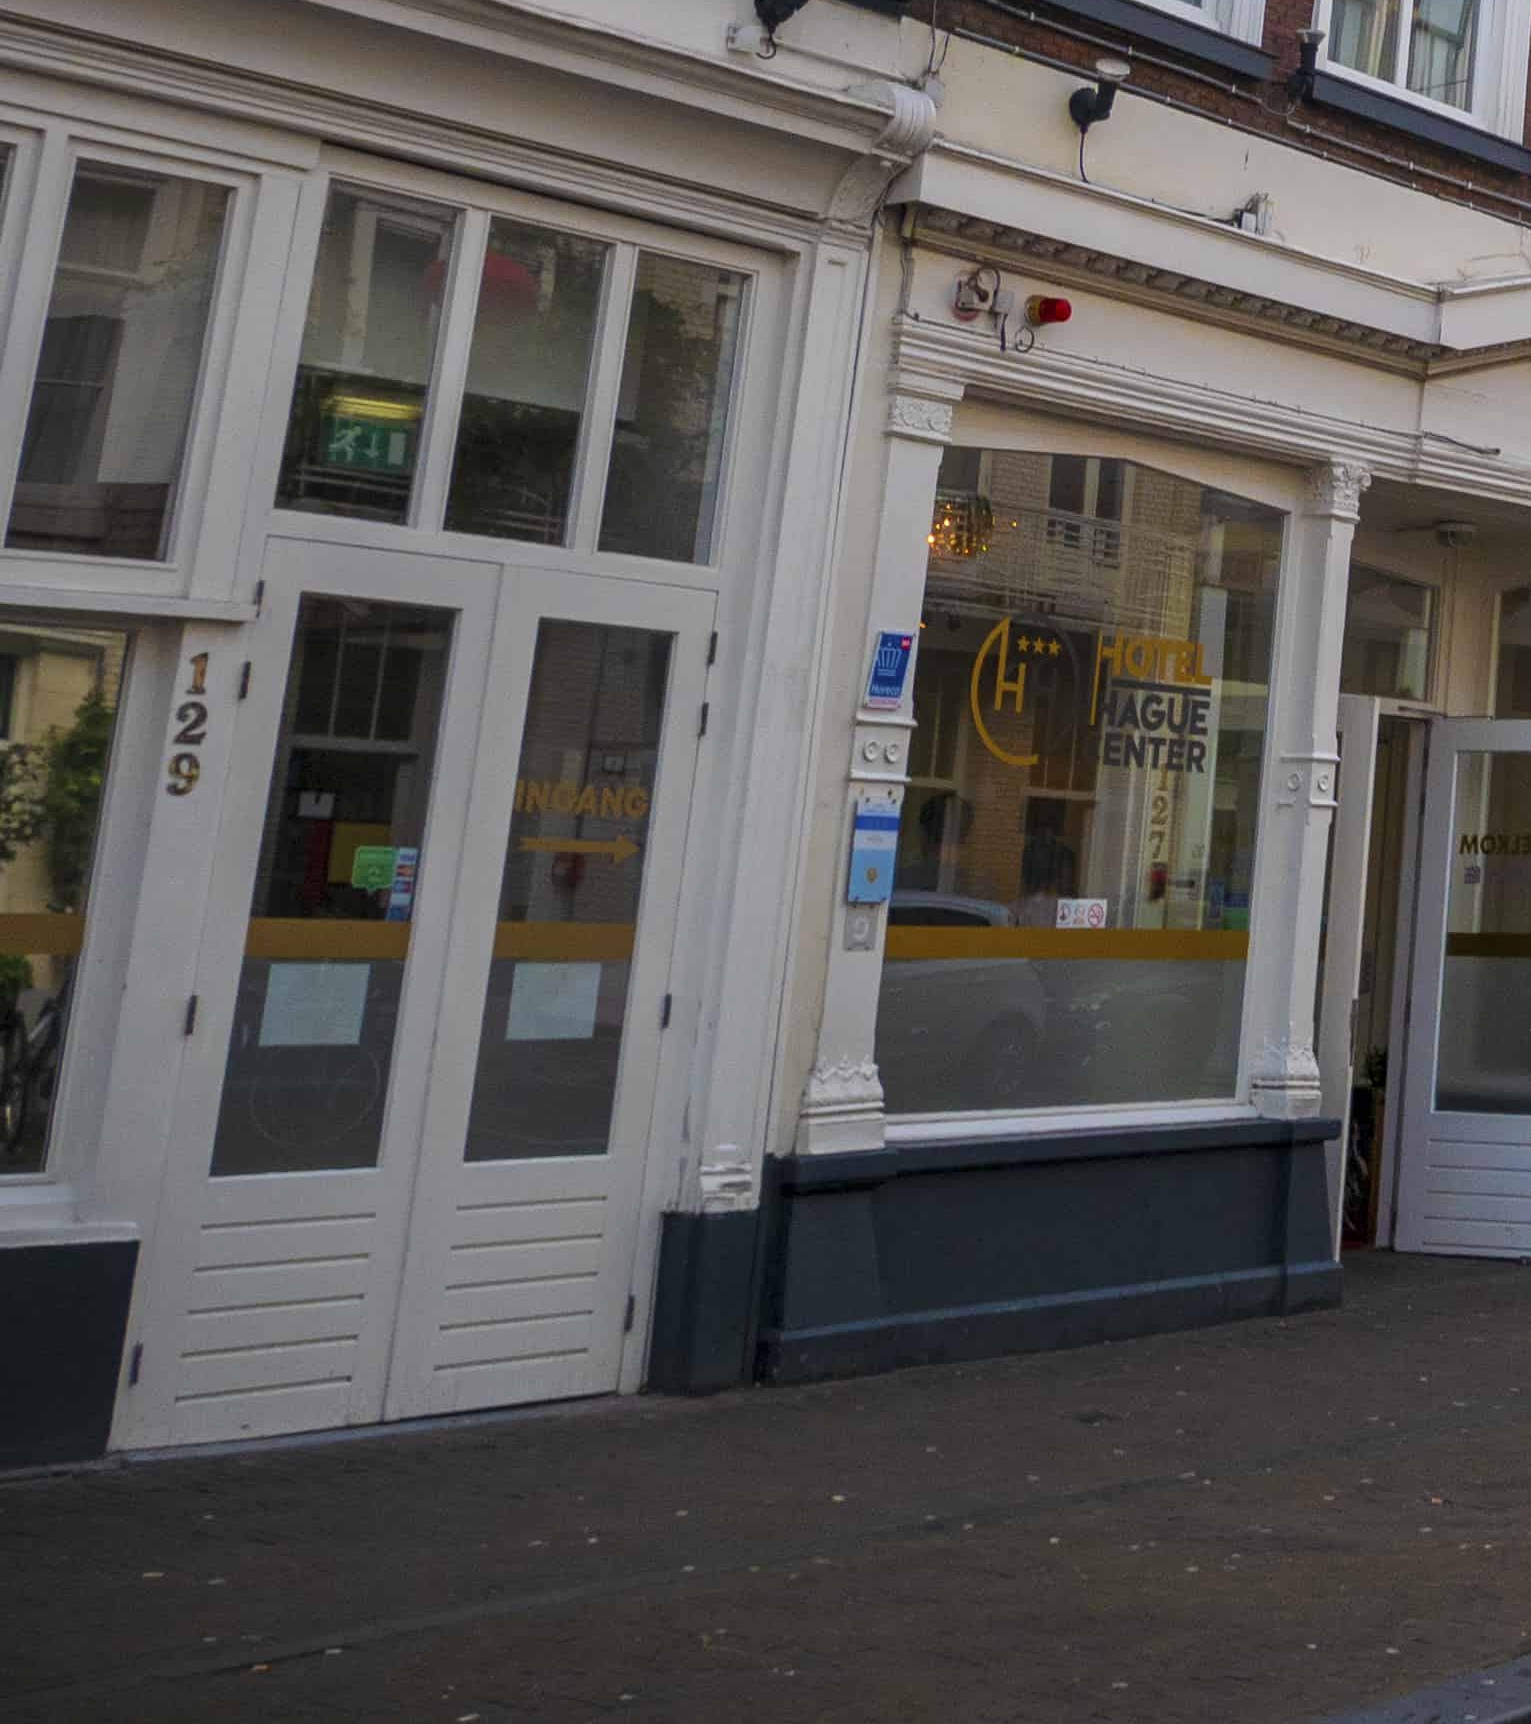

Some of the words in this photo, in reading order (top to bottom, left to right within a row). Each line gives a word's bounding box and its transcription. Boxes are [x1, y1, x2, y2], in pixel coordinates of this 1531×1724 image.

[1095, 629, 1213, 686] HOTEL
[166, 652, 209, 796] 129
[1097, 688, 1211, 736] HAGUE
[1102, 732, 1205, 774] ENTER
[514, 779, 648, 820] INGANG
